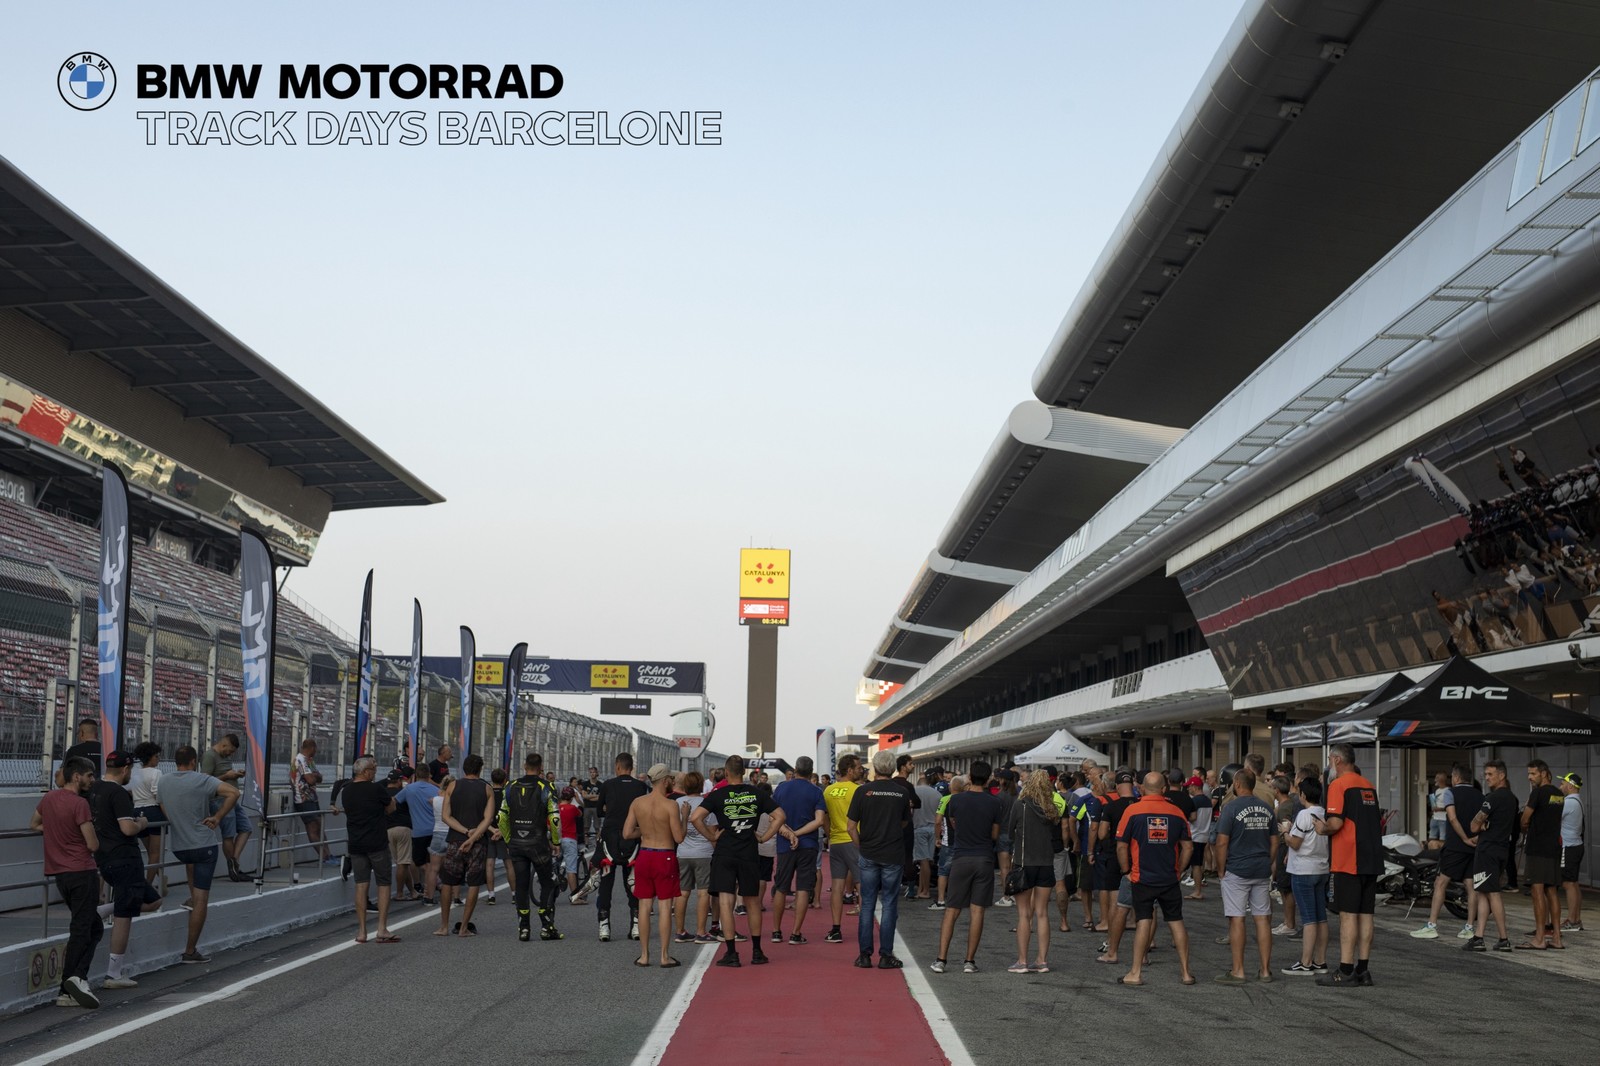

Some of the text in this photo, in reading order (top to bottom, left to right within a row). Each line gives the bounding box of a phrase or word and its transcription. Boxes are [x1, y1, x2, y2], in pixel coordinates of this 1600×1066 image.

[637, 664, 676, 676] GRAND
[641, 676, 672, 687] TOUR
[1440, 686, 1509, 700] BMC
[1529, 724, 1592, 735] bmc-moto.com
[748, 758, 777, 769] BMC
[829, 787, 848, 797] 46
[1235, 808, 1249, 822] DEUS
[1473, 871, 1486, 882] NIKE
